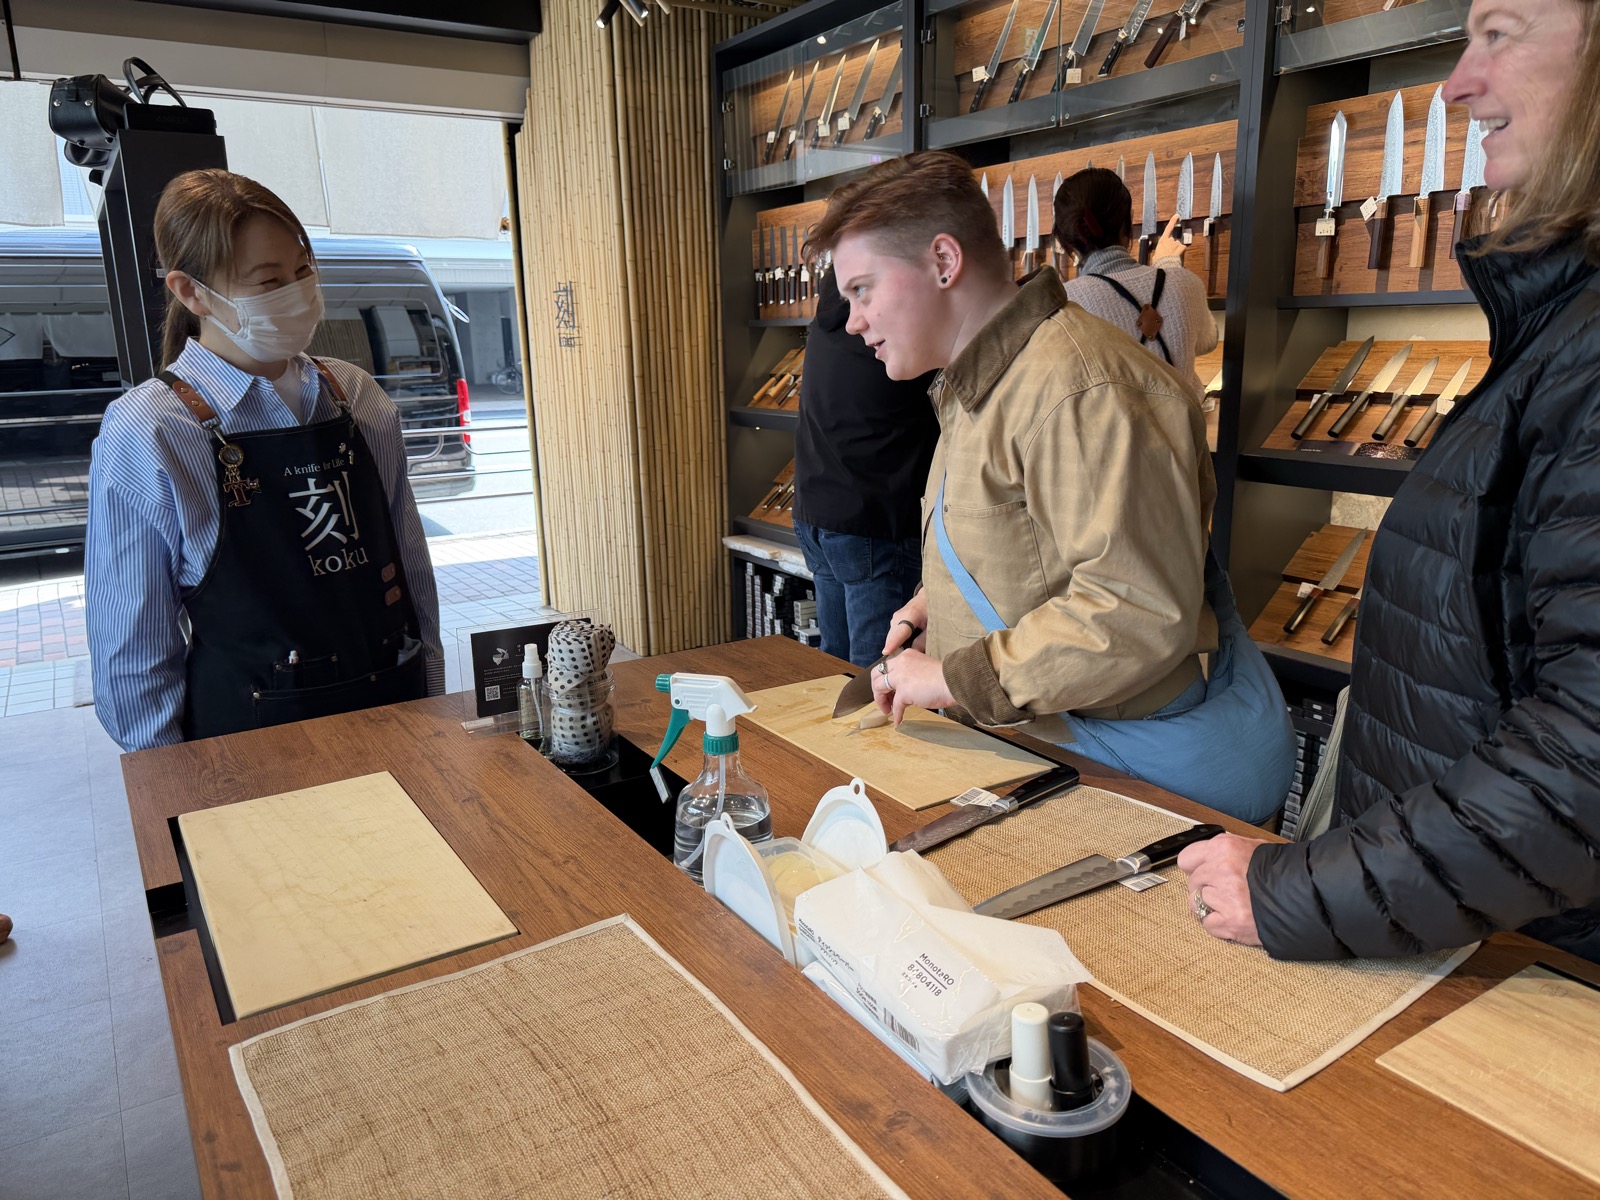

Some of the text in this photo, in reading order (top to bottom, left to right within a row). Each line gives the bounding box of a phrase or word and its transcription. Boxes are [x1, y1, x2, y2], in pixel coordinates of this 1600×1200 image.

[284, 466, 293, 476] A
[293, 463, 321, 475] knife
[331, 458, 345, 468] Life
[288, 471, 360, 551] 刻
[308, 547, 369, 576] koku
[919, 953, 955, 985] MonotaRO
